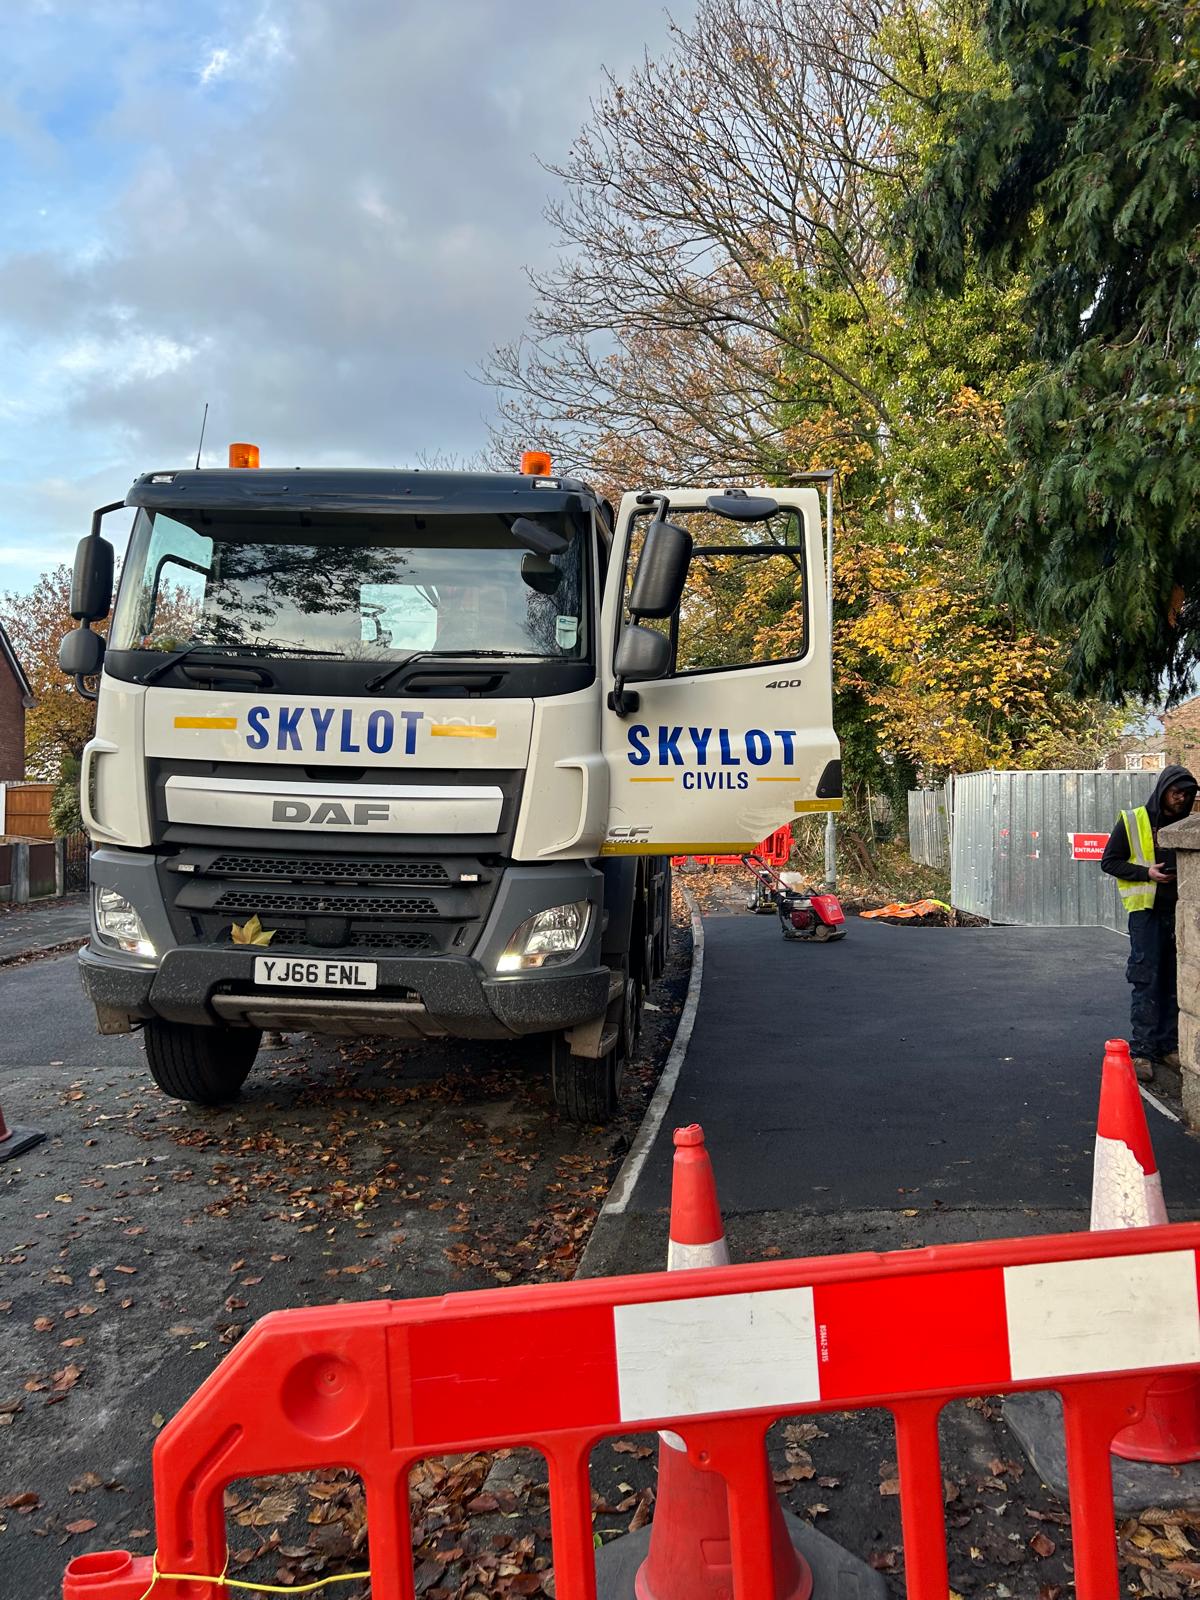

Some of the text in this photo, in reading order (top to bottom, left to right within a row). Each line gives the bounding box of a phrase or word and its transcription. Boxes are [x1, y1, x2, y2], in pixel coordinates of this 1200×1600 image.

[765, 679, 802, 689] 400
[246, 706, 424, 755] SKYLOT
[627, 725, 797, 766] SKYLOT
[682, 771, 749, 790] CIVILS
[272, 800, 390, 826] DAF
[608, 825, 653, 837] CF
[263, 961, 367, 986] YJ66 ENL
